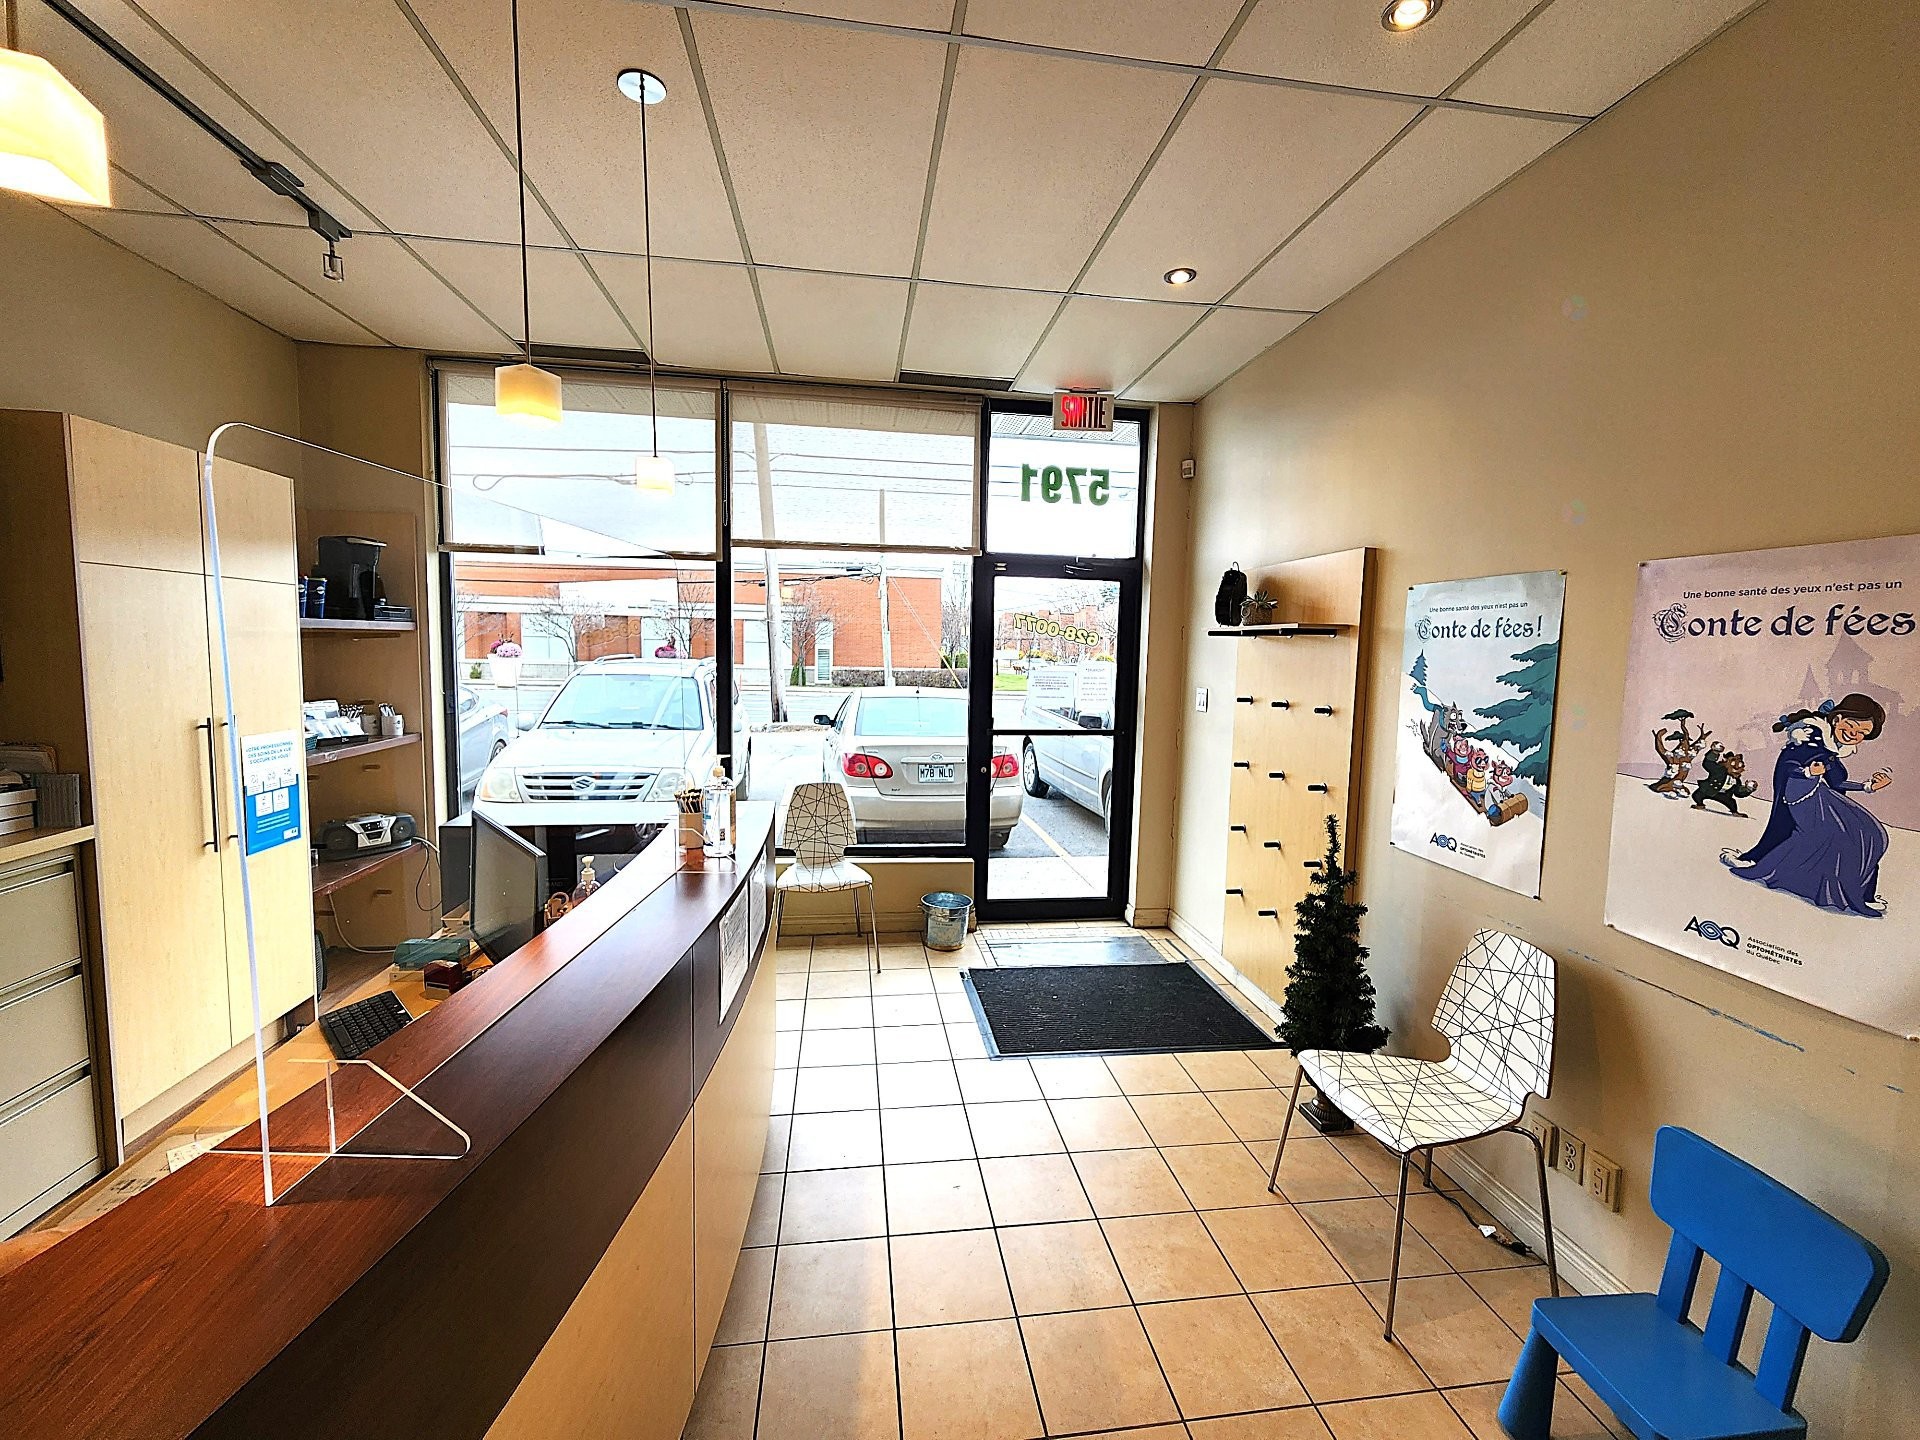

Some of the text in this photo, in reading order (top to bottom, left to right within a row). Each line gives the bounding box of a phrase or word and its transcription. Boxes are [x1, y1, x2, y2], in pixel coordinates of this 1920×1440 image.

[1061, 395, 1108, 429] SORTIE
[1683, 580, 1903, 599] Une bonne santé des yeux n'est pas un
[1481, 604, 1494, 612] yeux
[1508, 602, 1519, 610] pas
[1414, 614, 1467, 644] Conte
[1470, 617, 1491, 639] de
[1652, 602, 1916, 643] Conte de fées
[938, 768, 954, 778] NLD
[1745, 948, 1781, 965] du Québec
[1746, 942, 1803, 966] OPTOMÉTRISTES
[1747, 936, 1800, 957] Association des
